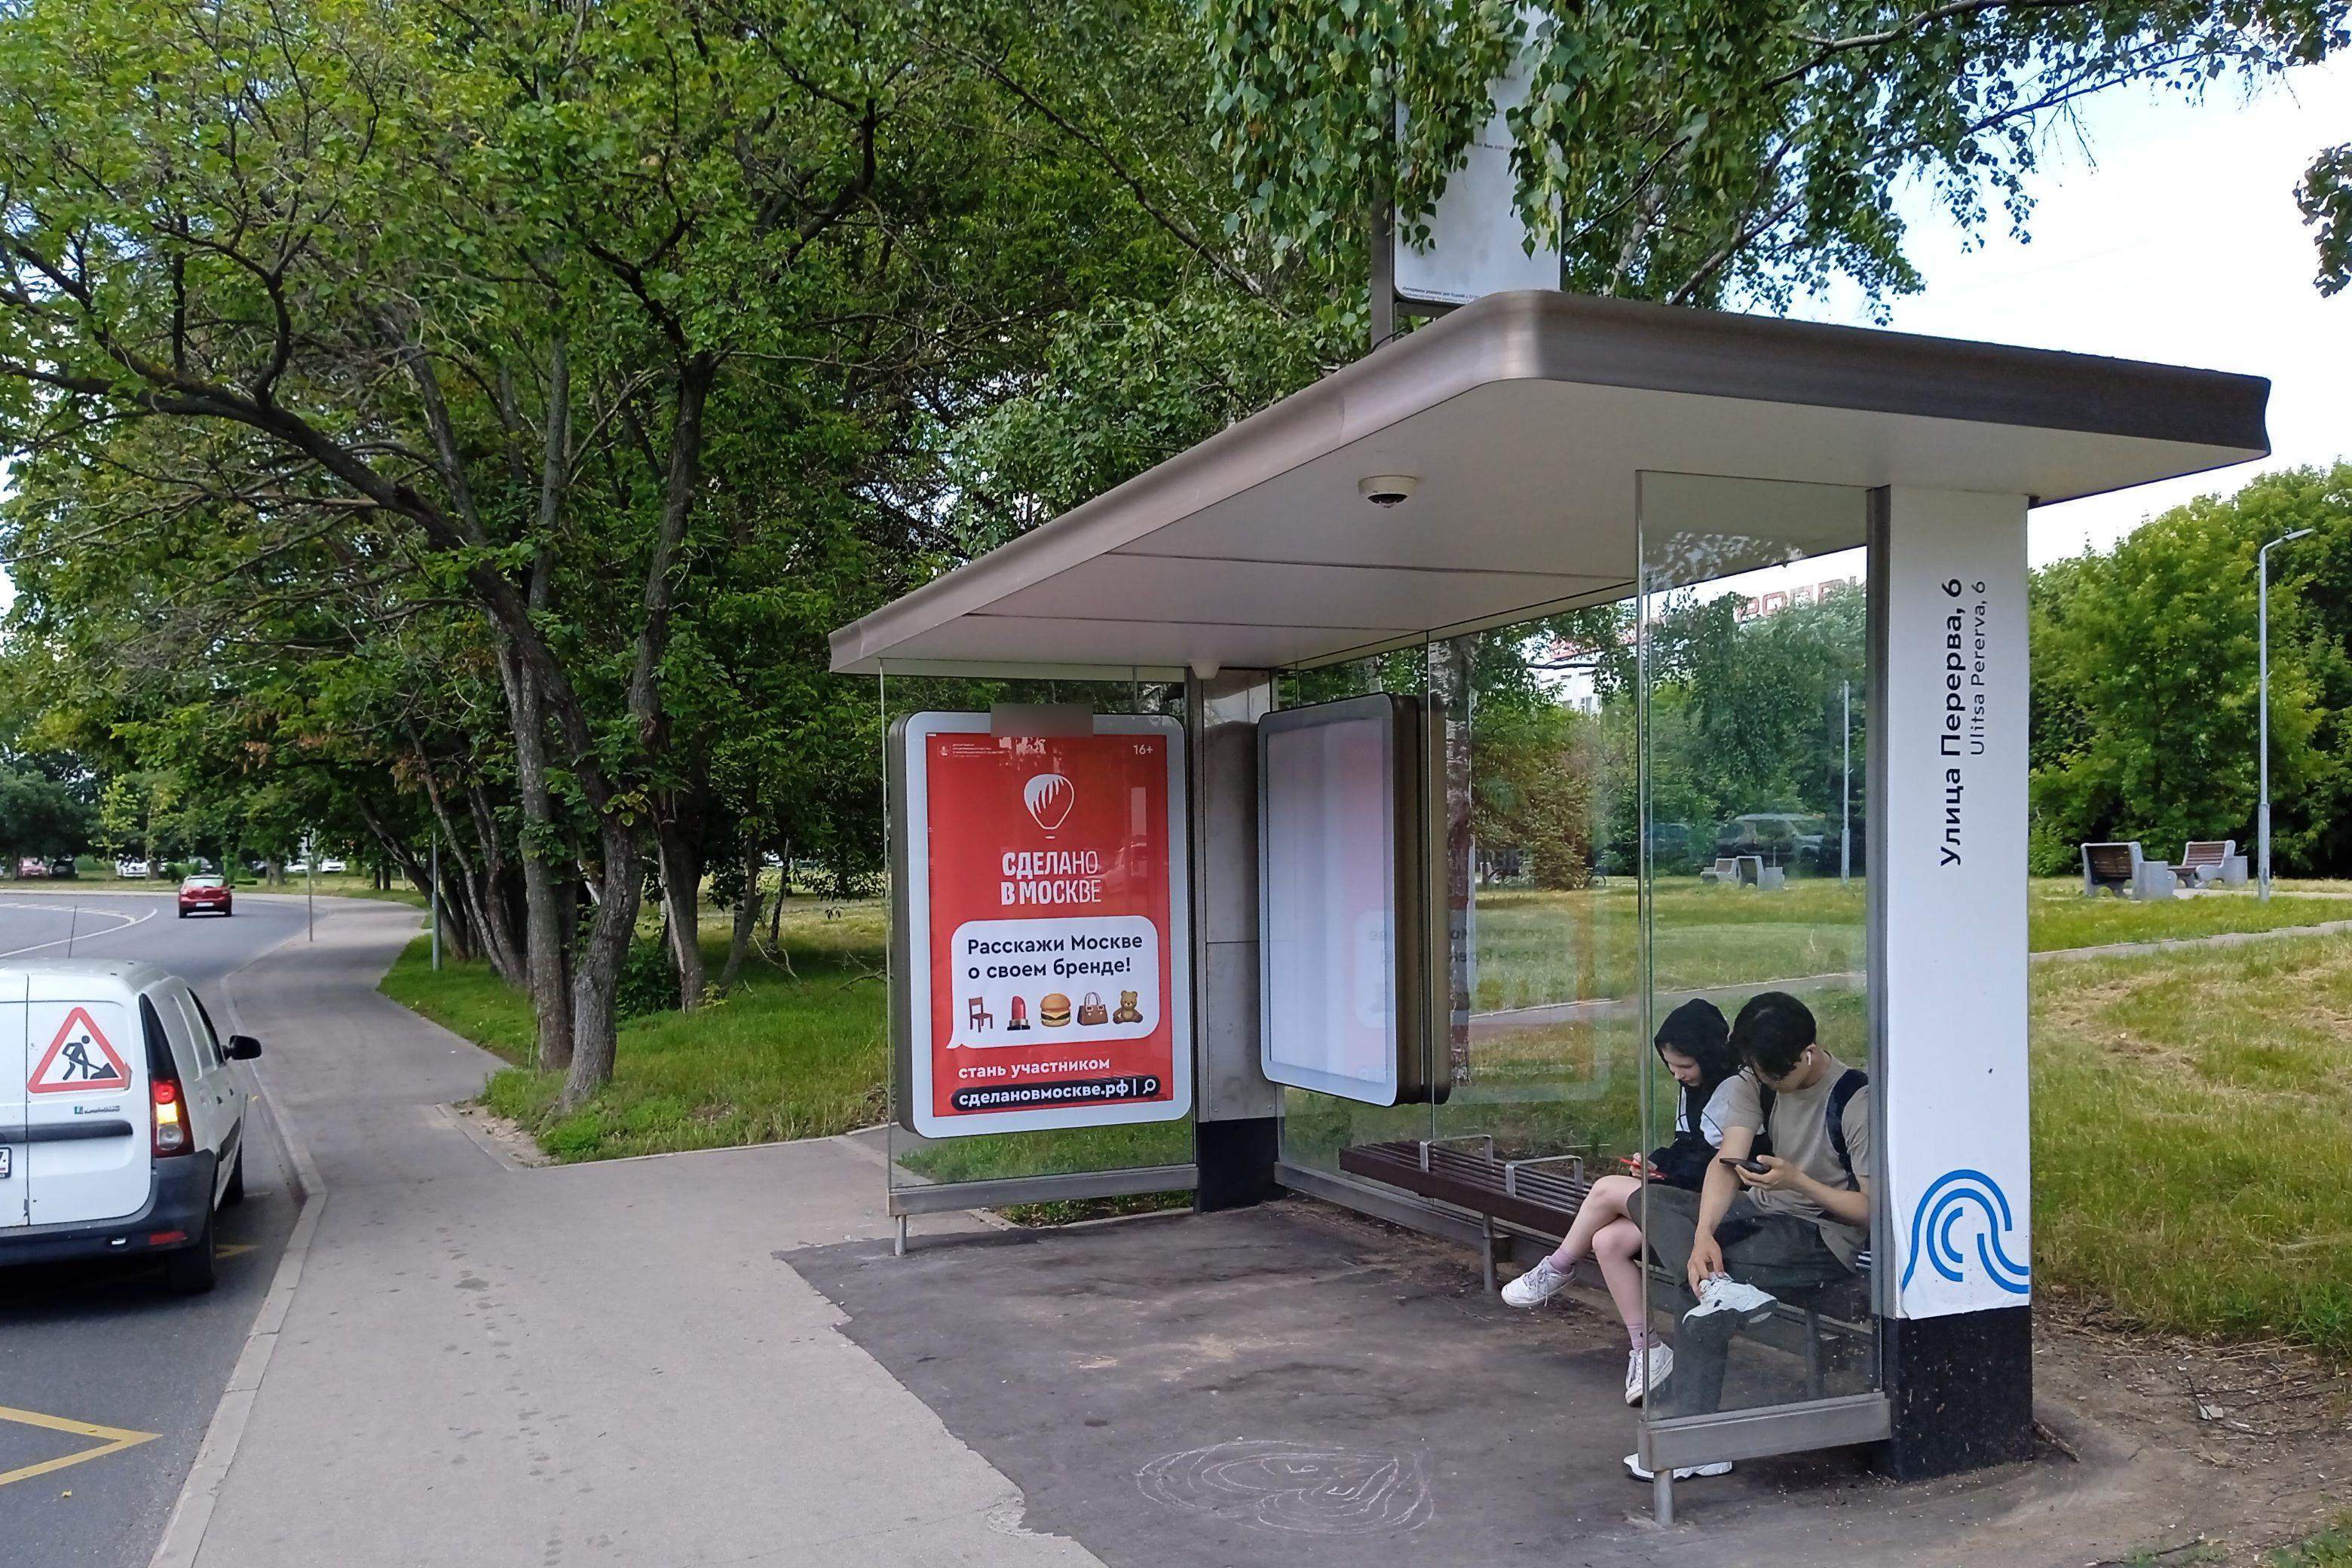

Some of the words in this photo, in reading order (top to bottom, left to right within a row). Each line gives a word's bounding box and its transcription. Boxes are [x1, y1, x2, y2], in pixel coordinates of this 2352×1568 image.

[1941, 578, 1962, 598] 6
[1971, 580, 1986, 594] 6
[1970, 599, 1988, 686] Pererva,
[1940, 607, 1966, 757] Перерва,
[1970, 693, 1986, 755] Ulitsa
[1133, 744, 1154, 755] 16+
[1940, 767, 1965, 867] Улица
[1001, 850, 1098, 880] СДЕЛАНО
[1000, 881, 1015, 905] В
[1018, 878, 1102, 905] МОСКВЕ
[967, 937, 1065, 955] Расскажи
[1070, 934, 1143, 951] Москве
[968, 966, 980, 979] о
[986, 963, 1047, 978] своем
[1052, 957, 1132, 978] бренде!
[957, 1062, 1007, 1080] стань
[1010, 1058, 1110, 1079] участником
[958, 1078, 1129, 1107] сделановмоскве.рф
